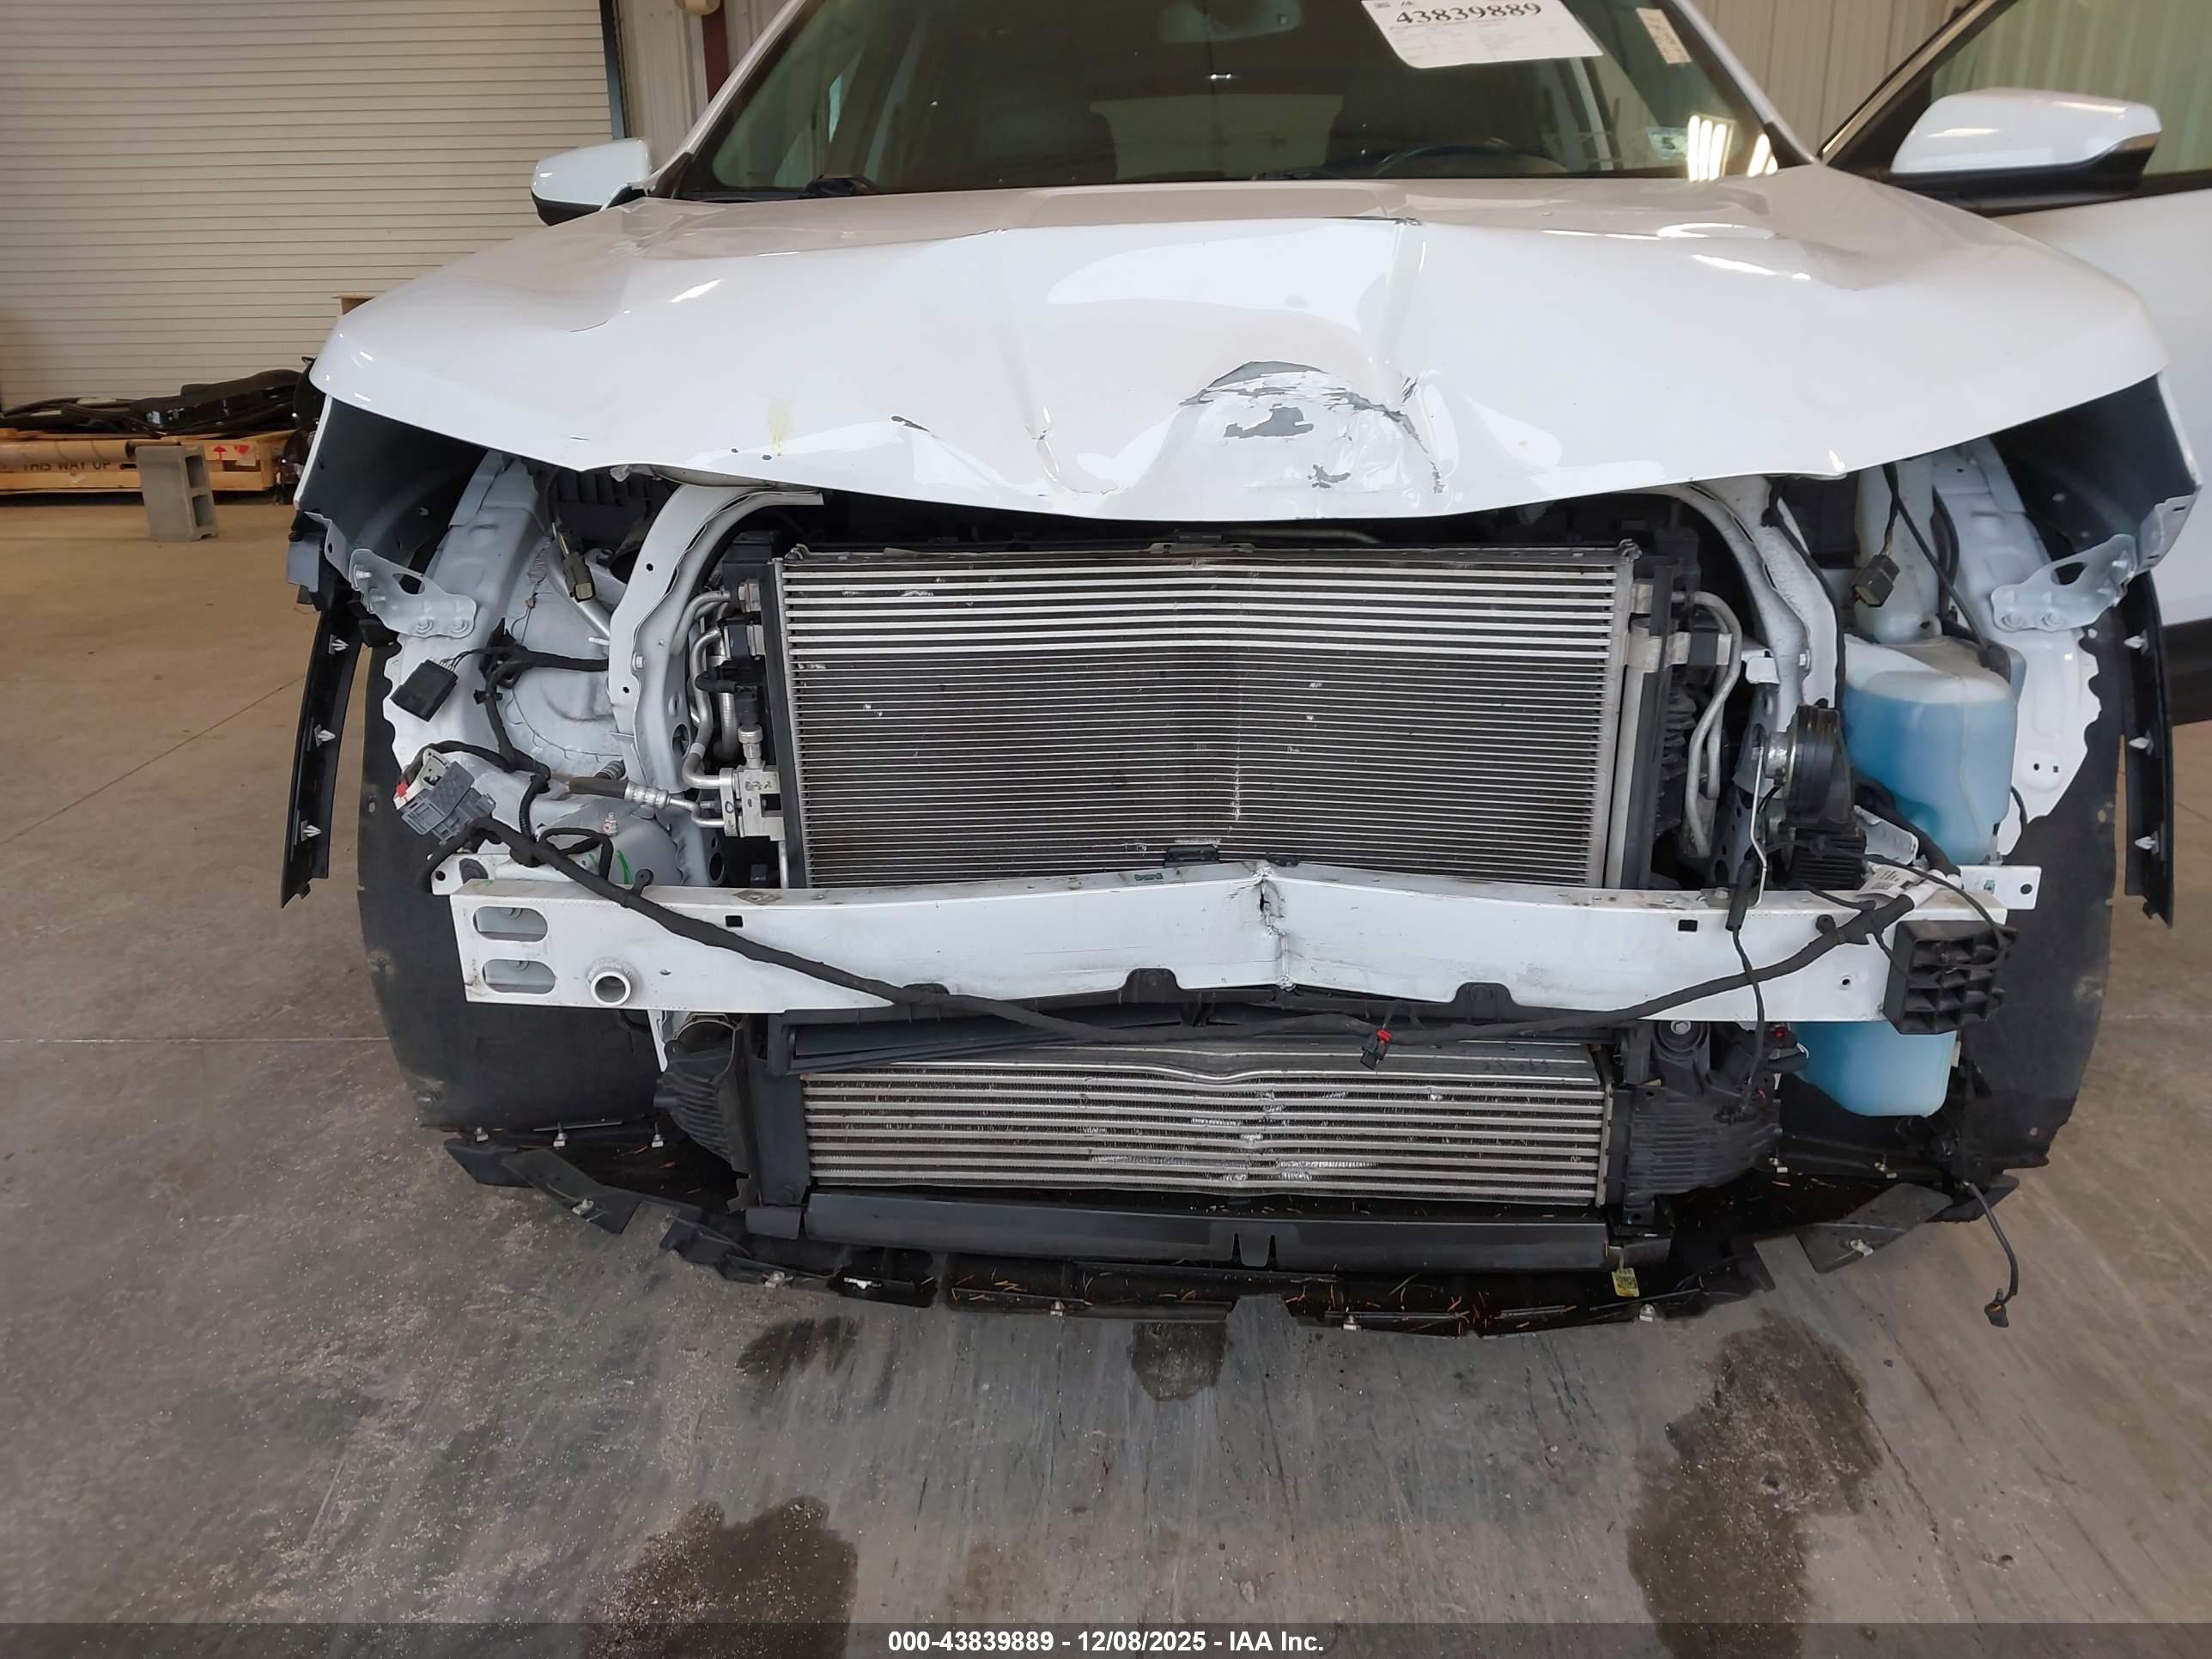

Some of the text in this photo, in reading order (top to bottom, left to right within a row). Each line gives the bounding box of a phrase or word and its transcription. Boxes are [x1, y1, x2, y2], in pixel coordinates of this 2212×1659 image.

[1396, 3, 1542, 24] 43839889
[58, 461, 85, 471] WAY
[92, 461, 112, 471] UP
